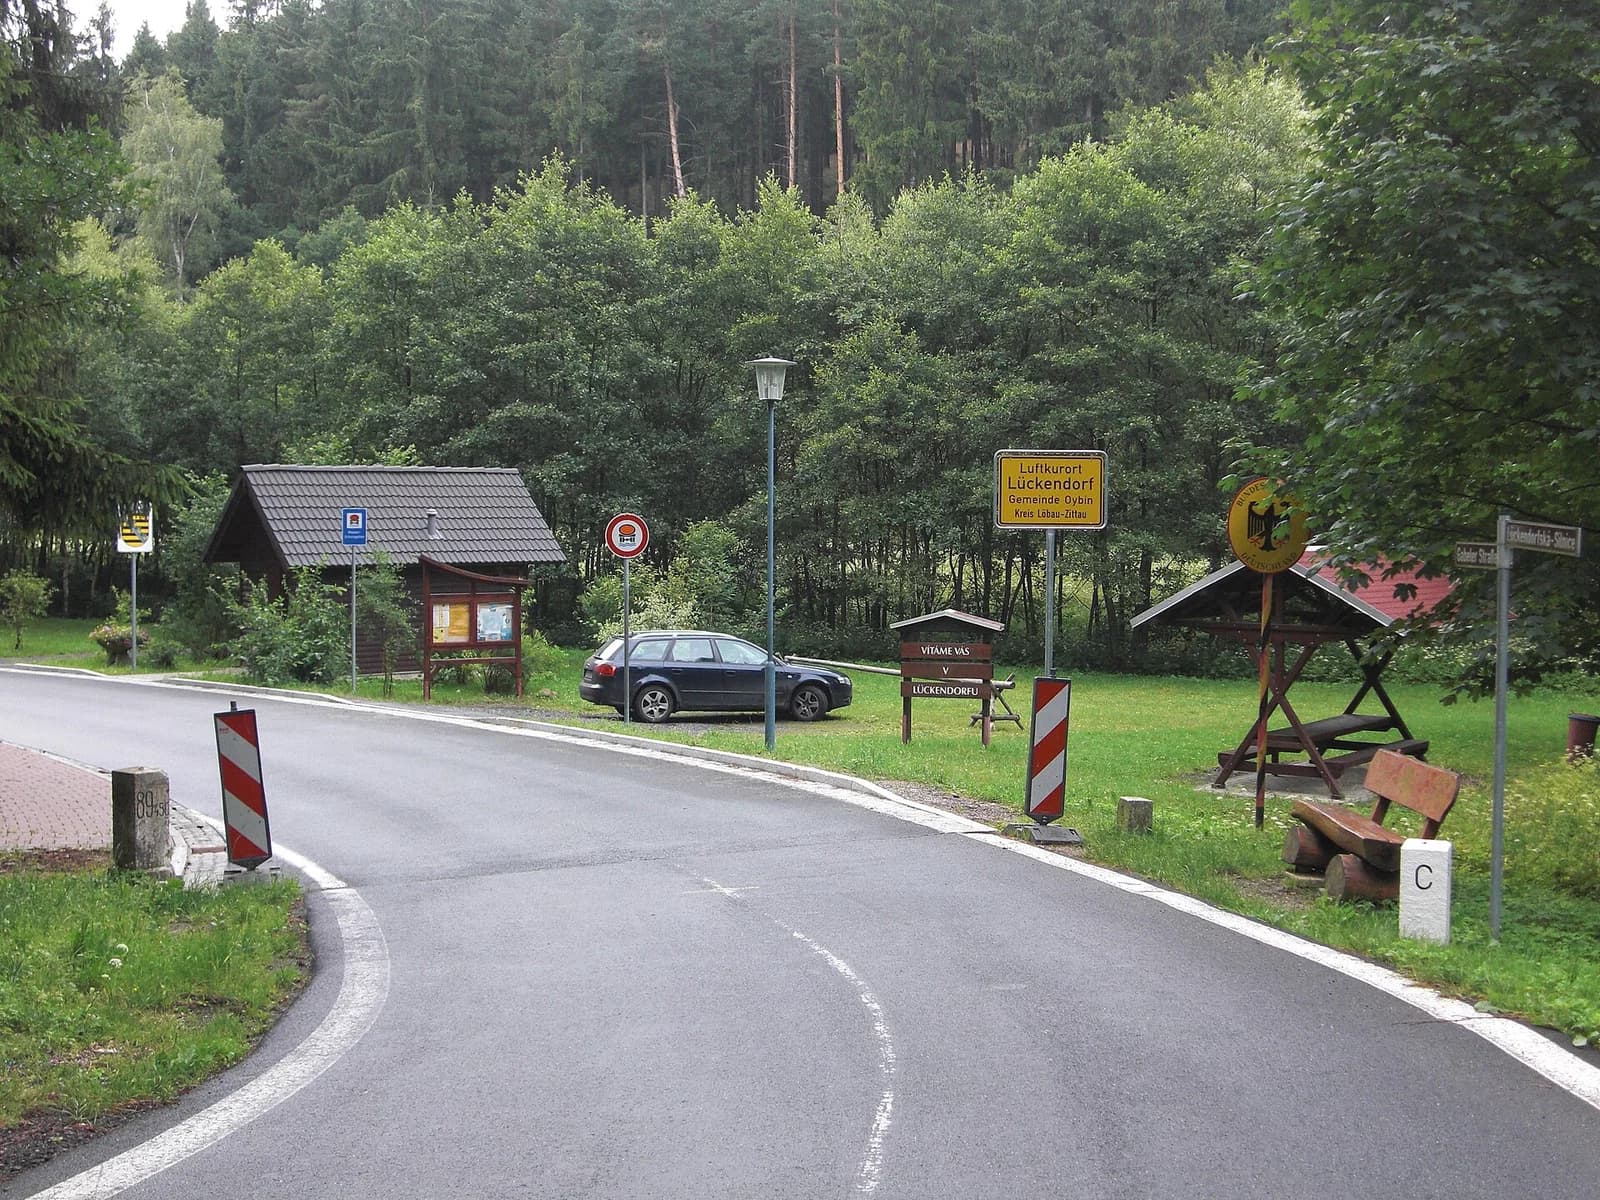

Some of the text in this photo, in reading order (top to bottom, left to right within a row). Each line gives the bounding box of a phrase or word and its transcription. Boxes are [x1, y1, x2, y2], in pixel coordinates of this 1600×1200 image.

[1020, 463, 1082, 474] Luftkurort
[1008, 476, 1095, 491] Lückendorf
[1008, 494, 1093, 506] Gemeinde Oybin
[1014, 508, 1087, 519] Kreis Löbau-Zittau
[920, 645, 970, 656] VÍTÁME VÁS
[942, 666, 949, 675] V
[912, 684, 979, 696] LÜCKENDORFU
[1415, 864, 1432, 890] C
